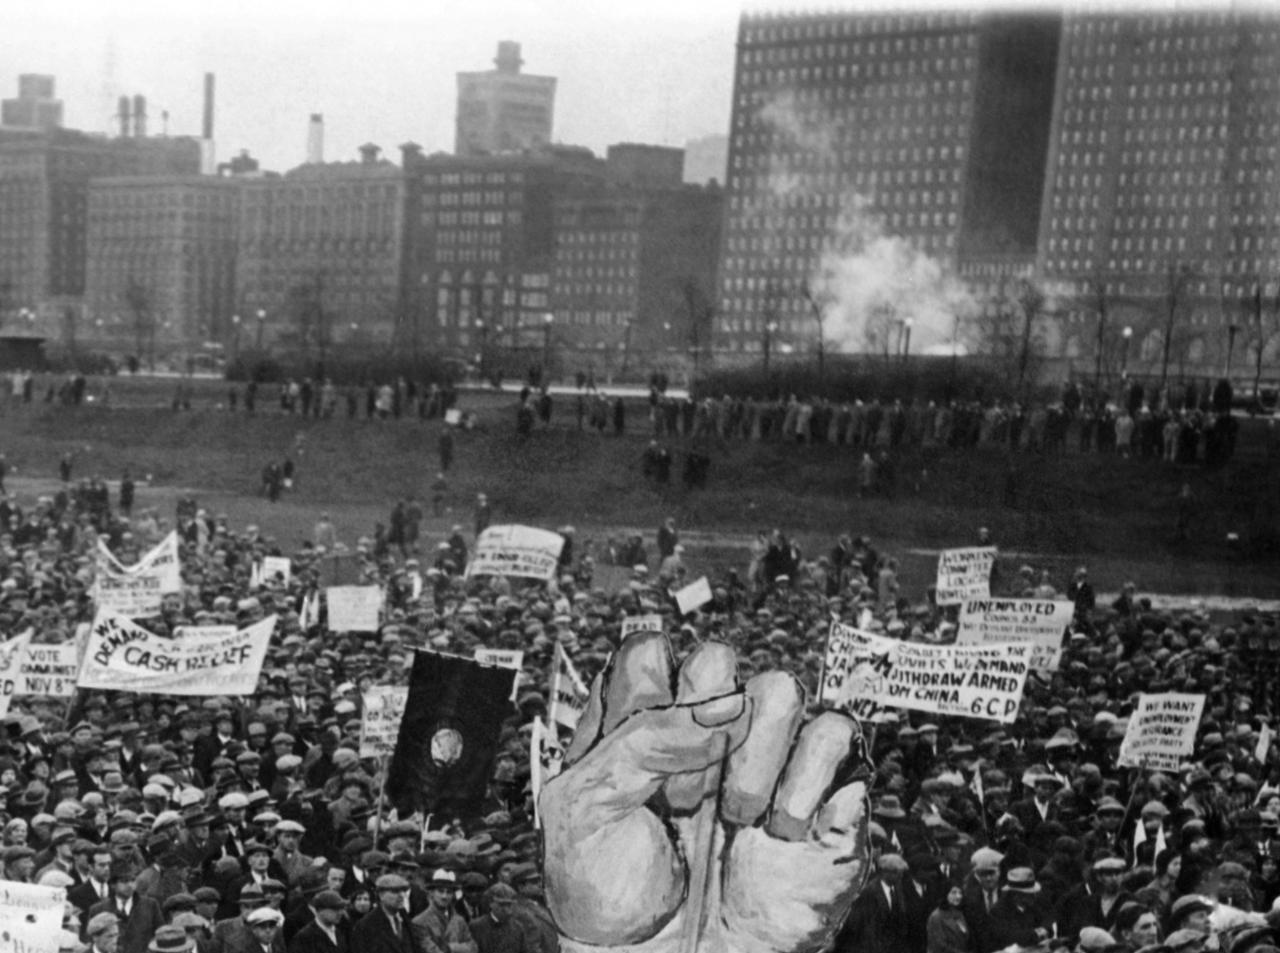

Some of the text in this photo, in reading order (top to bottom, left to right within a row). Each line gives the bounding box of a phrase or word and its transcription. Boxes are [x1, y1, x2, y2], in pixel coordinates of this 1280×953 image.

[966, 600, 1056, 615] UNEMPLOYED
[94, 618, 120, 637] WE
[28, 649, 61, 662] VOTE
[93, 629, 149, 667] DEMAND
[124, 646, 179, 672] CASH
[25, 677, 53, 692] NOV
[967, 671, 1020, 693] ARMED
[914, 687, 960, 704] CHINA
[1145, 700, 1196, 712] WE WANT
